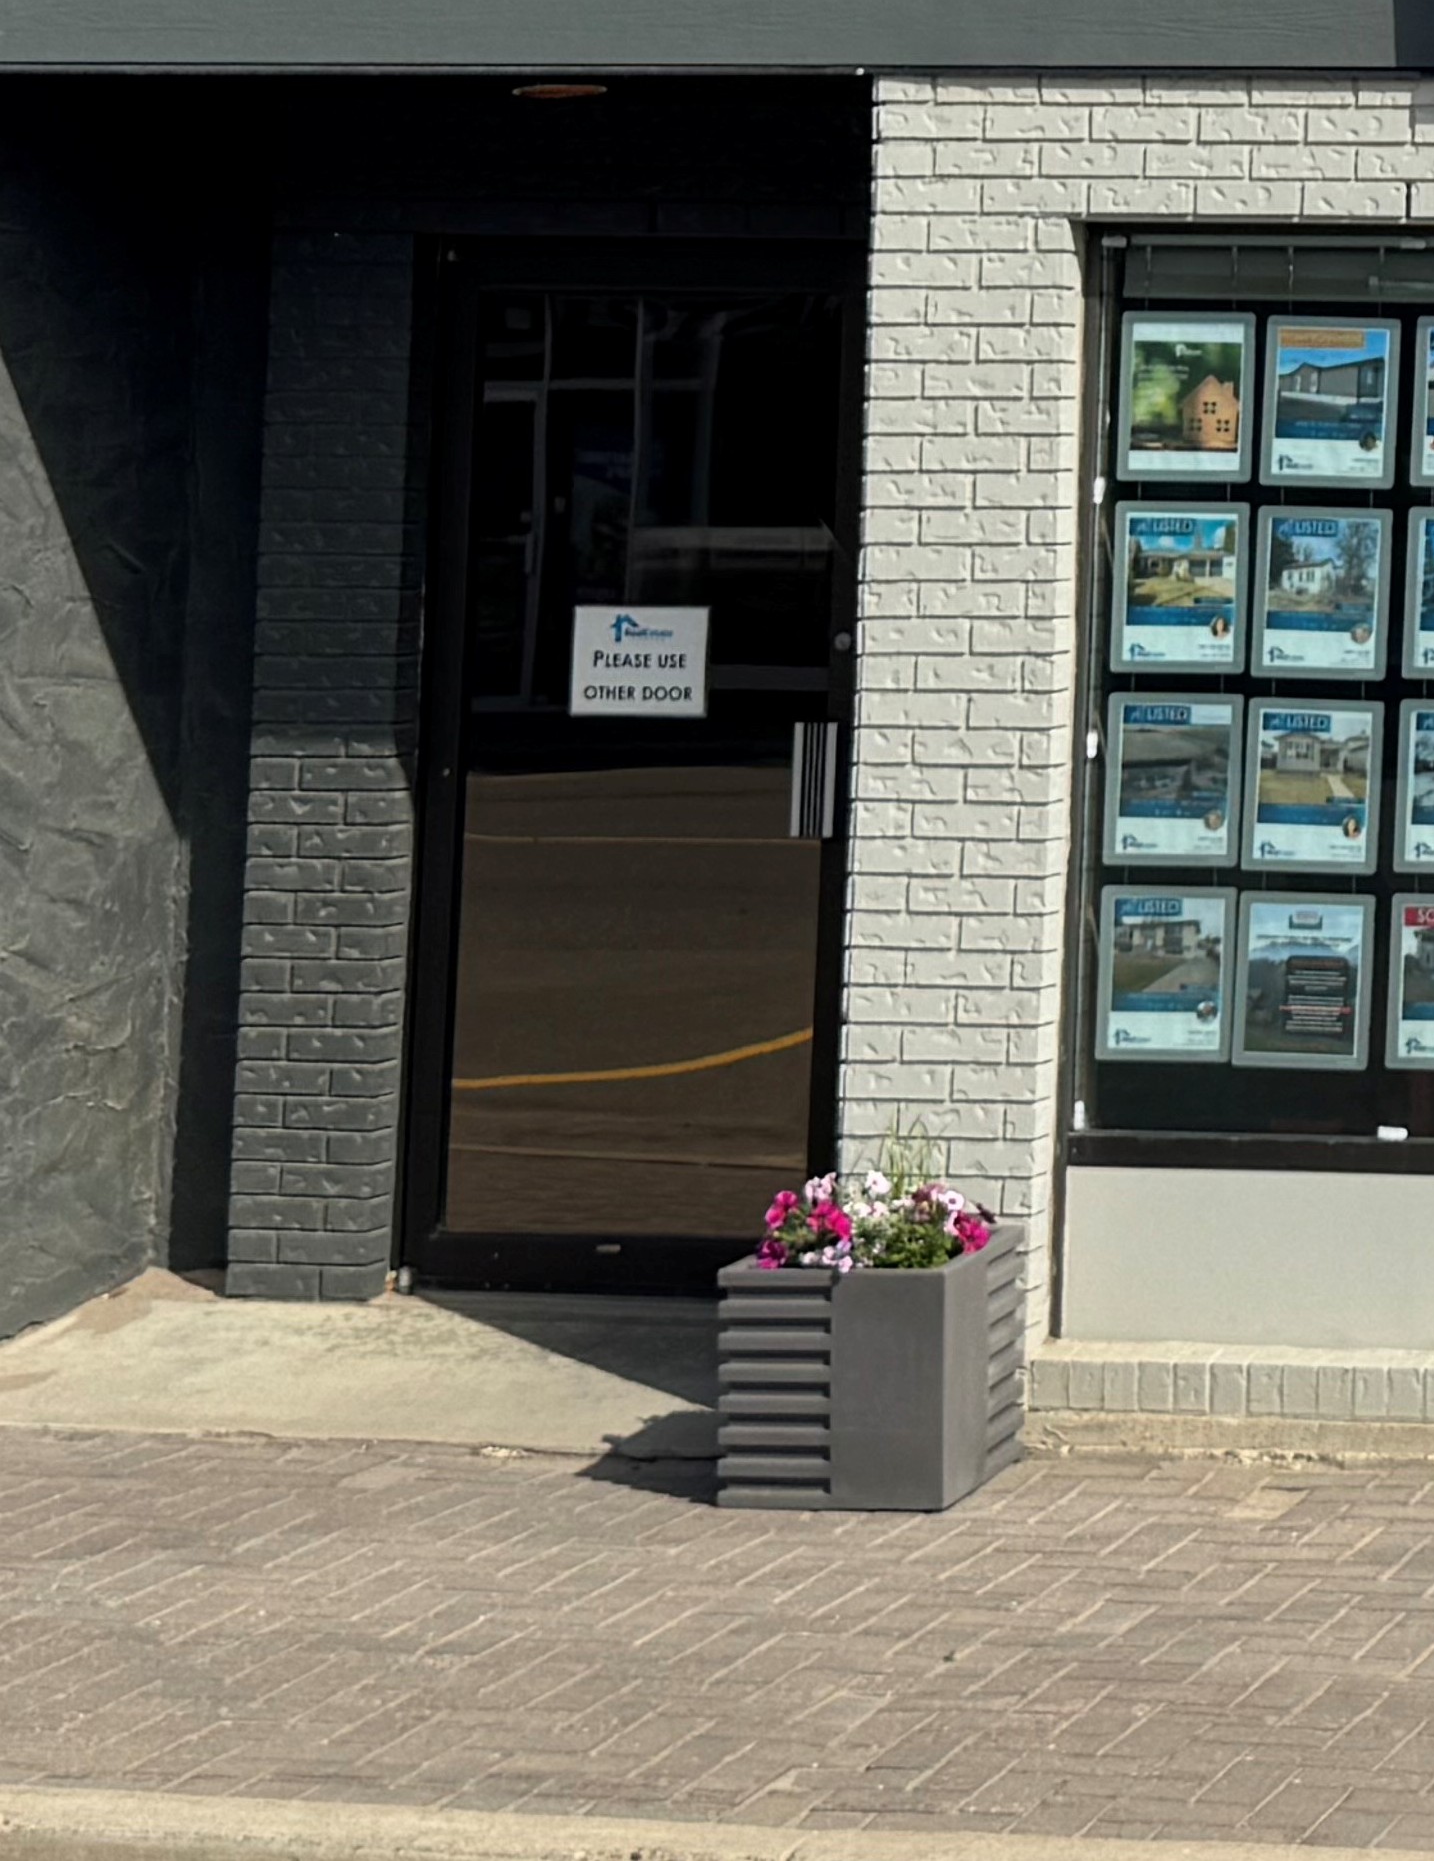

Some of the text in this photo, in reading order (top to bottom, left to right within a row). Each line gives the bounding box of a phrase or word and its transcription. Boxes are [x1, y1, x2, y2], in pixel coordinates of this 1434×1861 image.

[1152, 518, 1194, 533] LISTED
[1295, 520, 1336, 535] LISTED
[593, 649, 687, 669] PLEASE USE
[583, 685, 693, 701] OTHER DOOR
[1146, 706, 1188, 721] LISTED
[1286, 714, 1328, 729] LISTED
[1137, 899, 1180, 914] LISTED
